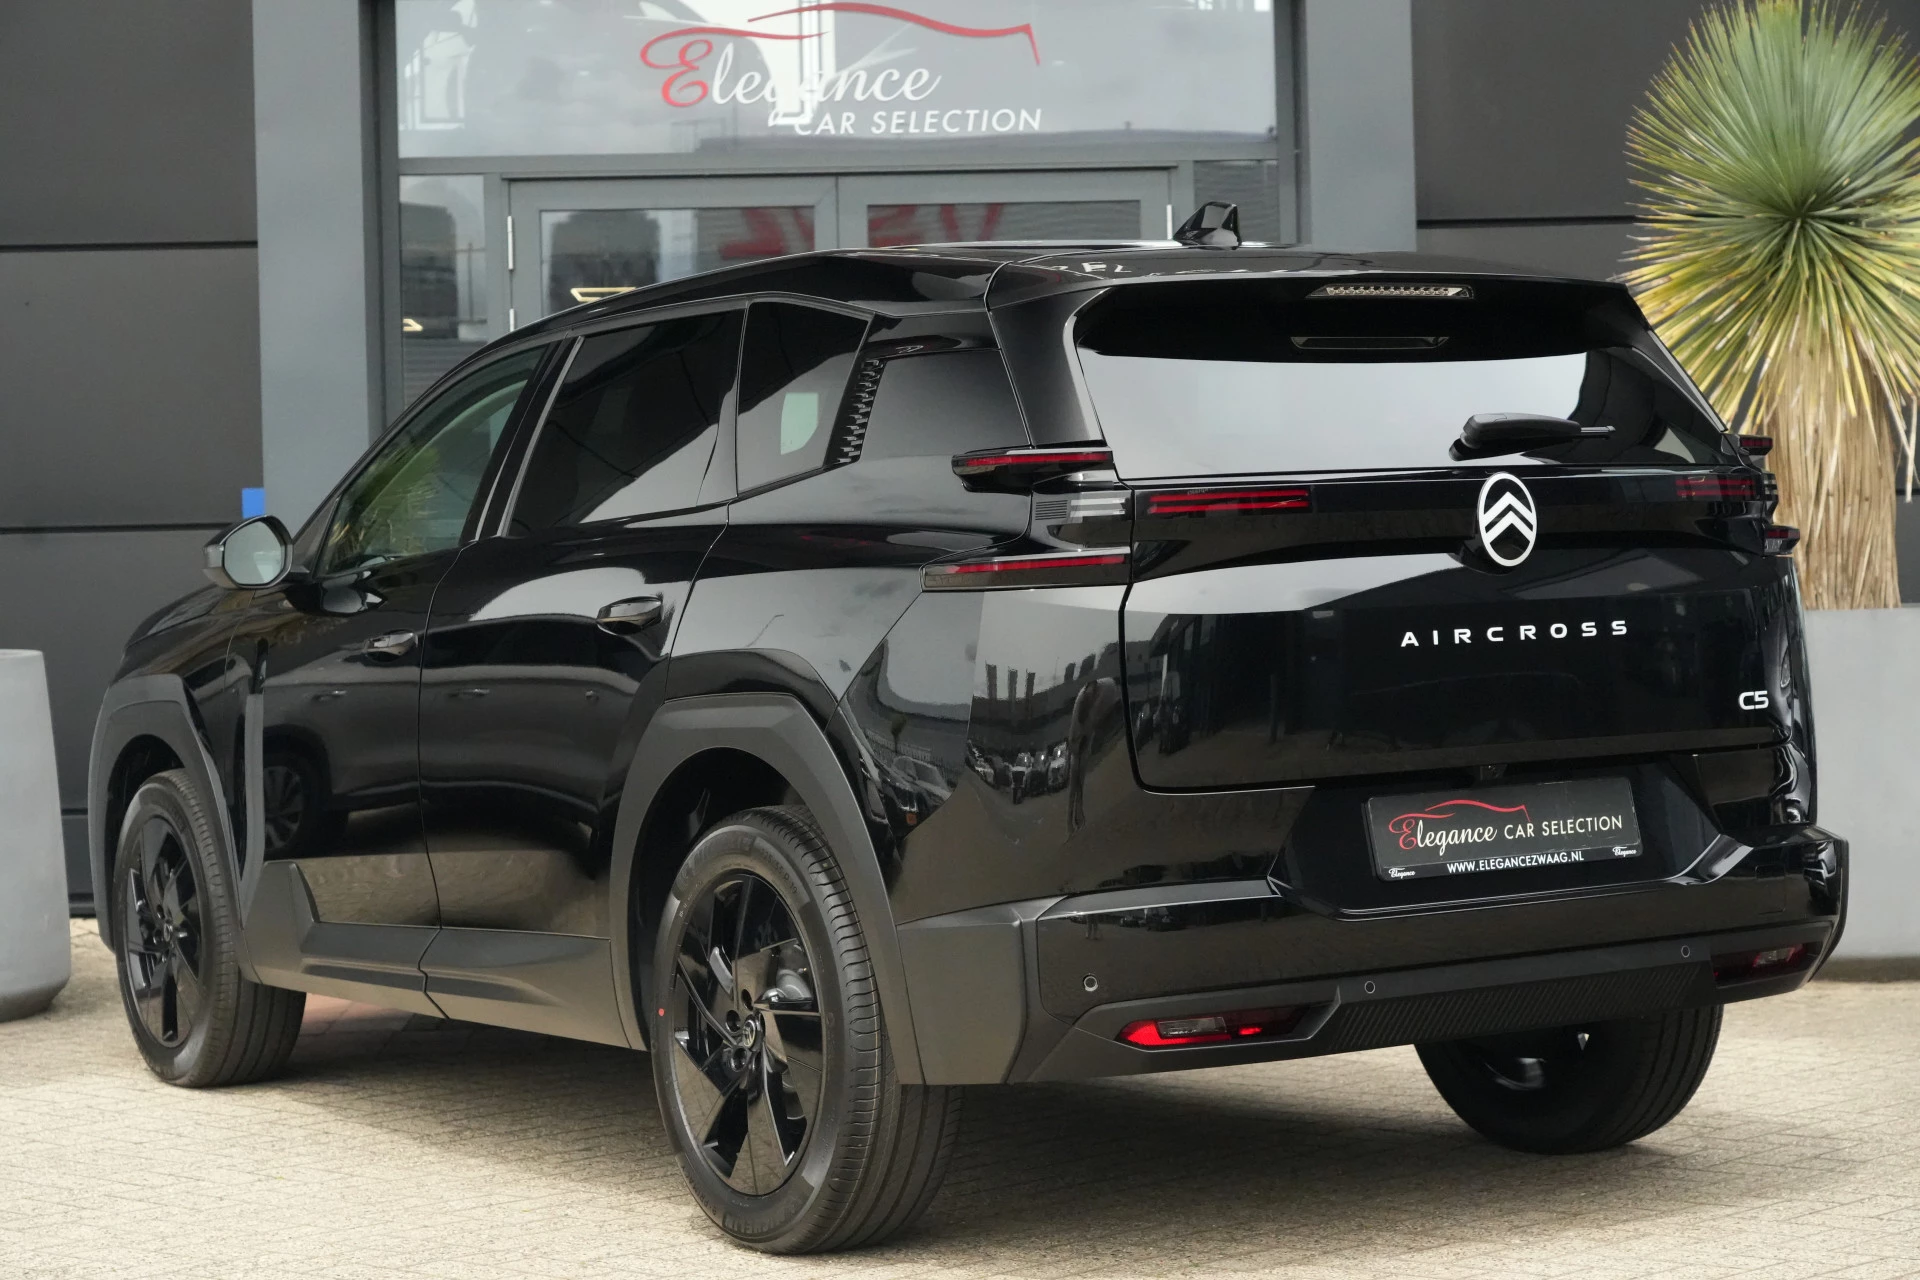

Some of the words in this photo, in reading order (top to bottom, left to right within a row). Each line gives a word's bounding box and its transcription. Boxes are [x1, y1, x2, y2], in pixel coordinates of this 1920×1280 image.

[794, 111, 856, 135] CAR
[870, 108, 1042, 134] SELECTION
[1400, 619, 1628, 648] AIRCROSS
[1738, 690, 1770, 711] C5
[1388, 812, 1498, 857] Elegance
[1503, 822, 1536, 841] CAR
[1541, 814, 1624, 837] SELECTION
[1446, 850, 1586, 874] WWW.ELEGANCEZWAAG.NL
